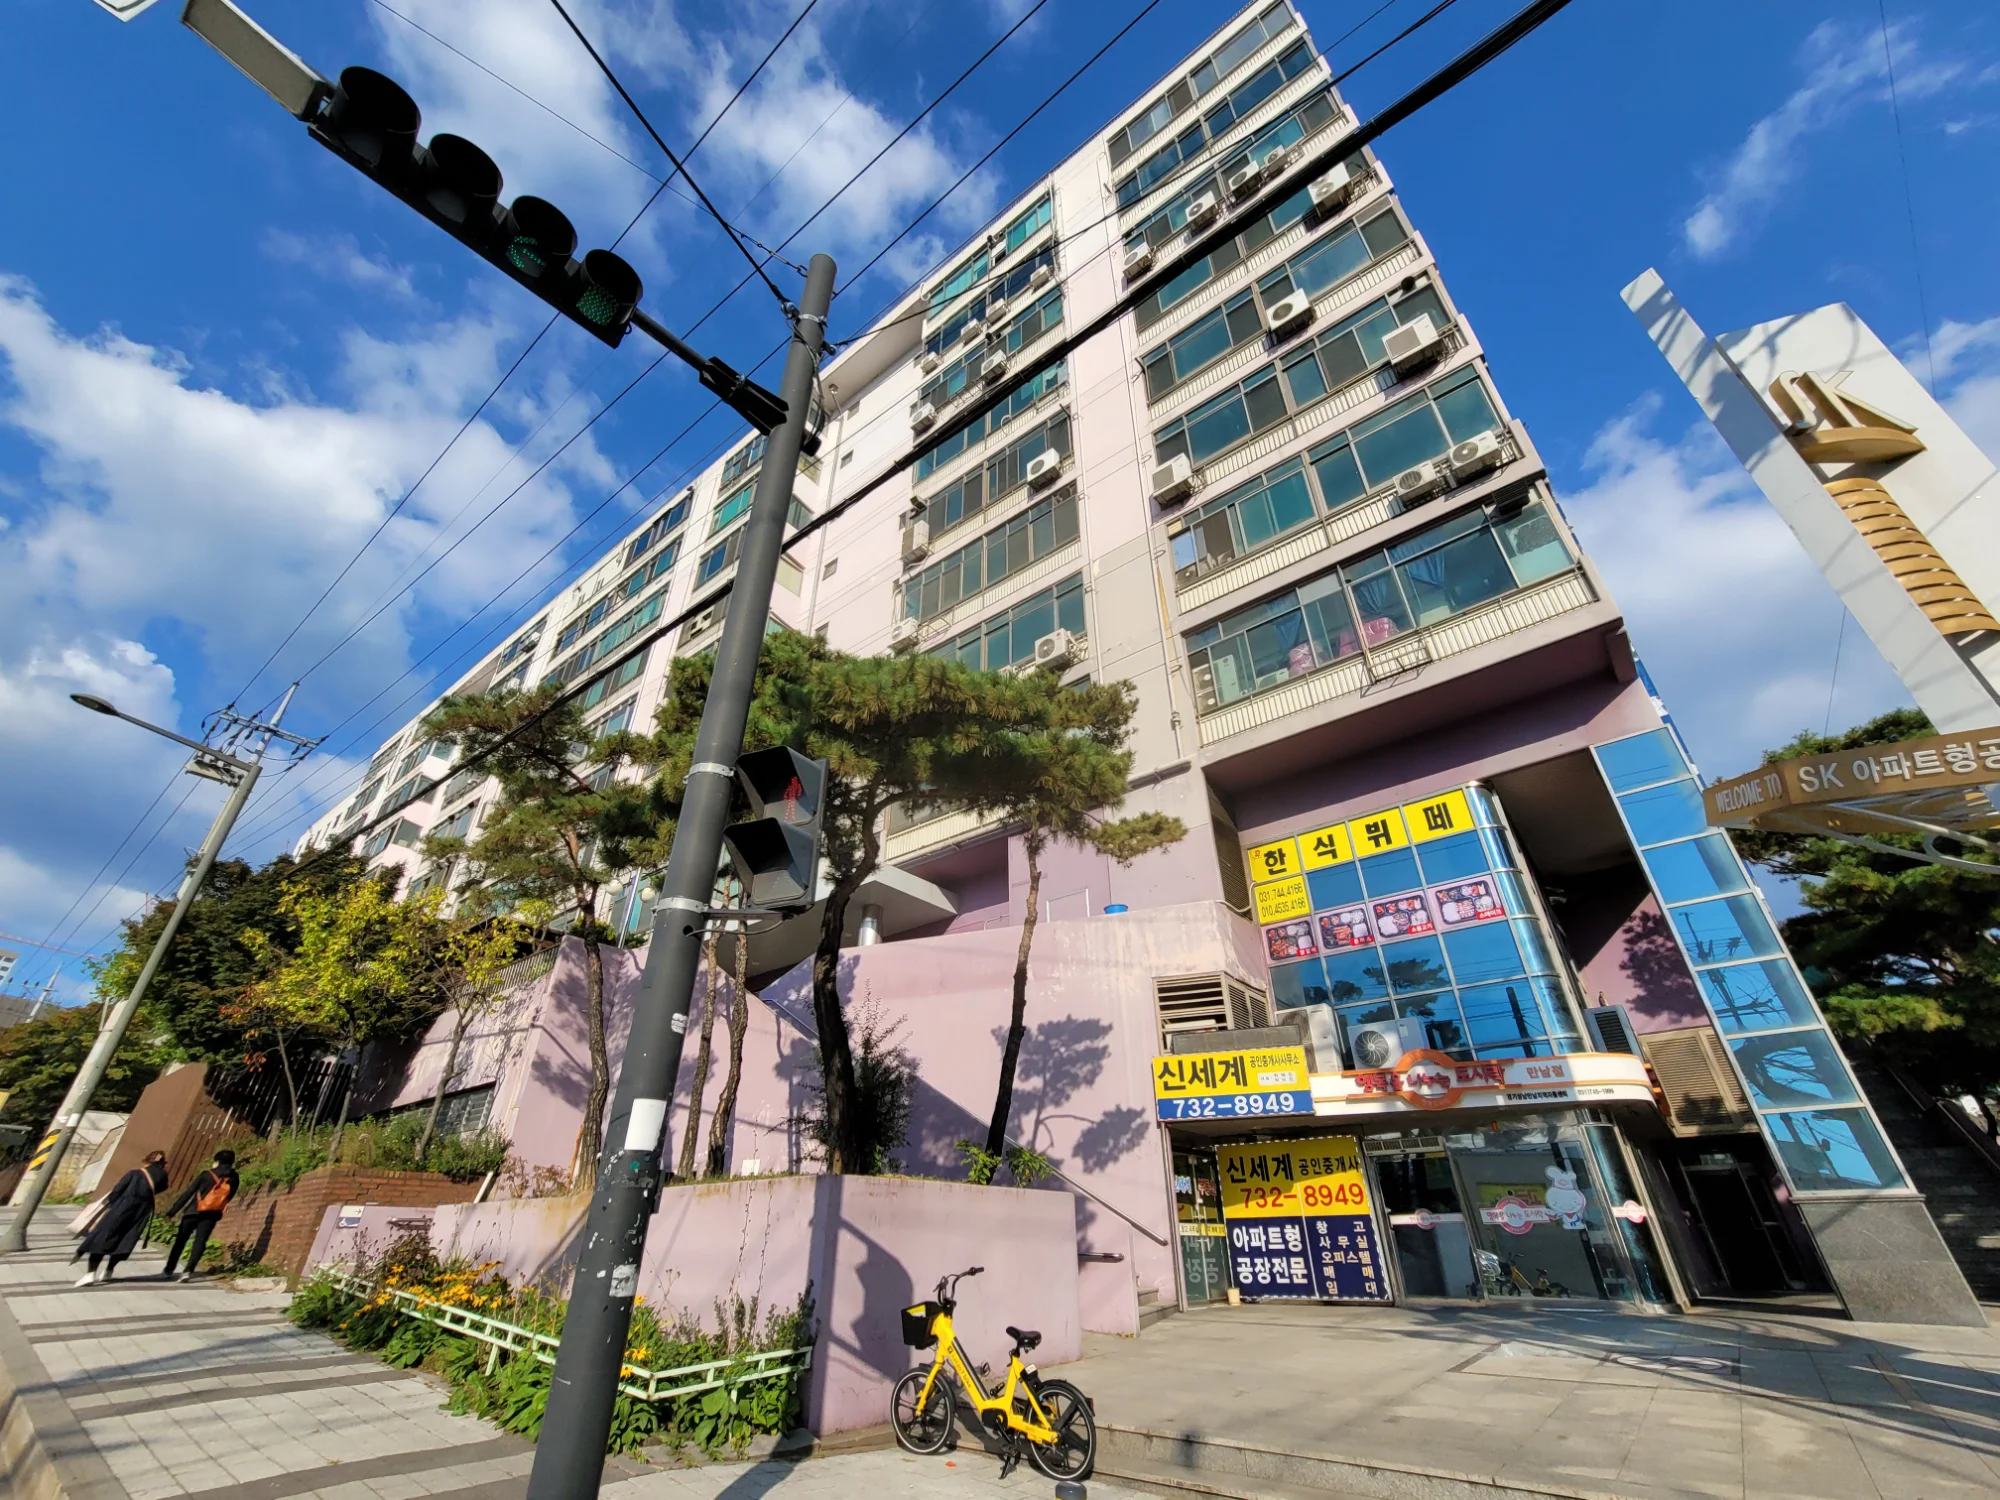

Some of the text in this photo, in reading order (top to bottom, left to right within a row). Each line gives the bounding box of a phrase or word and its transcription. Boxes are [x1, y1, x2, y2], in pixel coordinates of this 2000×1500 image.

[1770, 370, 1919, 436] SK
[1799, 762, 1844, 792] SK
[1715, 773, 1782, 813] WELCOME TO
[1158, 1055, 1248, 1091] 신세계
[1249, 1053, 1300, 1068] 공인중개사사무소
[1454, 1064, 1505, 1086] 도시락
[1526, 1065, 1565, 1079] 만남점
[1173, 1092, 1295, 1118] 732-8949
[1226, 1153, 1359, 1184] 신세계 공인중개사
[1233, 1224, 1302, 1252] 아파트형
[1237, 1256, 1308, 1284] 공장전문
[1322, 1251, 1372, 1264] 오피스텔
[962, 1374, 972, 1388] bike
